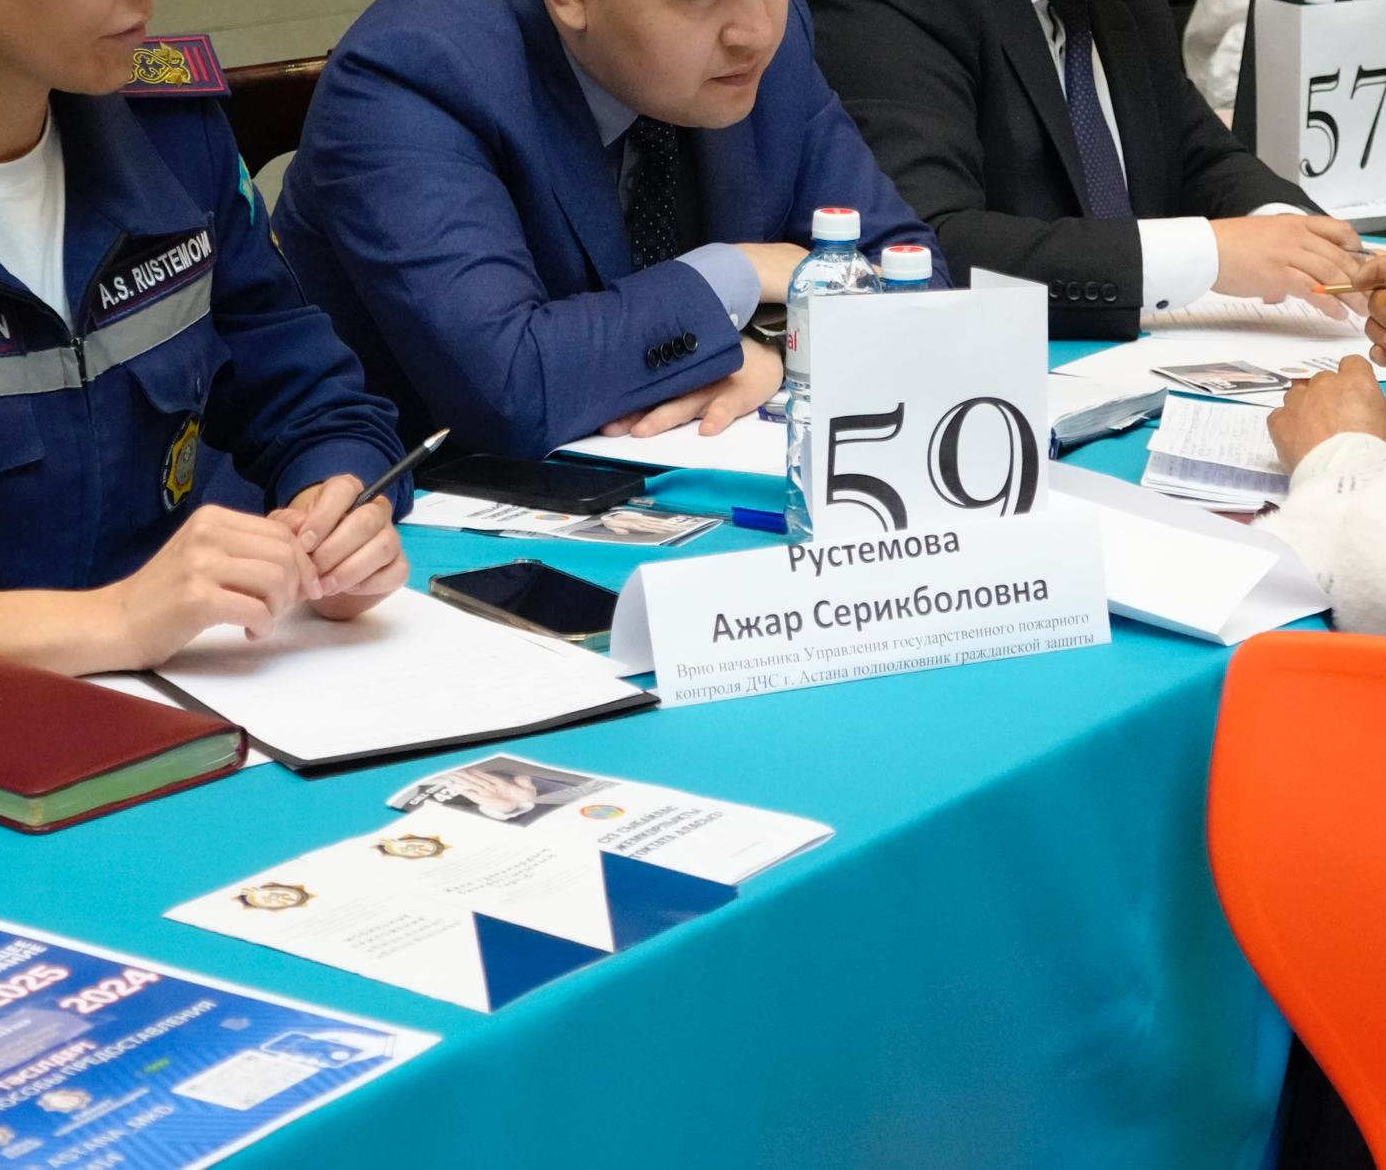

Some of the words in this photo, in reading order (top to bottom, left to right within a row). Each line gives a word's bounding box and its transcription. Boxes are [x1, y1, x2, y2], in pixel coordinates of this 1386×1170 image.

[98, 276, 134, 310] A.S.
[826, 397, 1040, 532] 59
[788, 530, 960, 577] Рустемова
[713, 609, 803, 643] Ажар
[813, 579, 1049, 632] Серикболовна
[675, 683, 741, 701] контроля
[745, 673, 782, 693] ДЧС
[784, 676, 795, 686] г.
[800, 667, 849, 683] Астана
[853, 653, 951, 678] подполковник
[955, 639, 1040, 665] гражданской
[1045, 633, 1095, 651] защиты
[677, 662, 714, 680] Врио
[719, 653, 800, 673] начальника
[804, 639, 889, 663] Управления
[893, 624, 1015, 652] государственного
[1018, 613, 1090, 634] пожарного
[59, 968, 159, 1014] 2024
